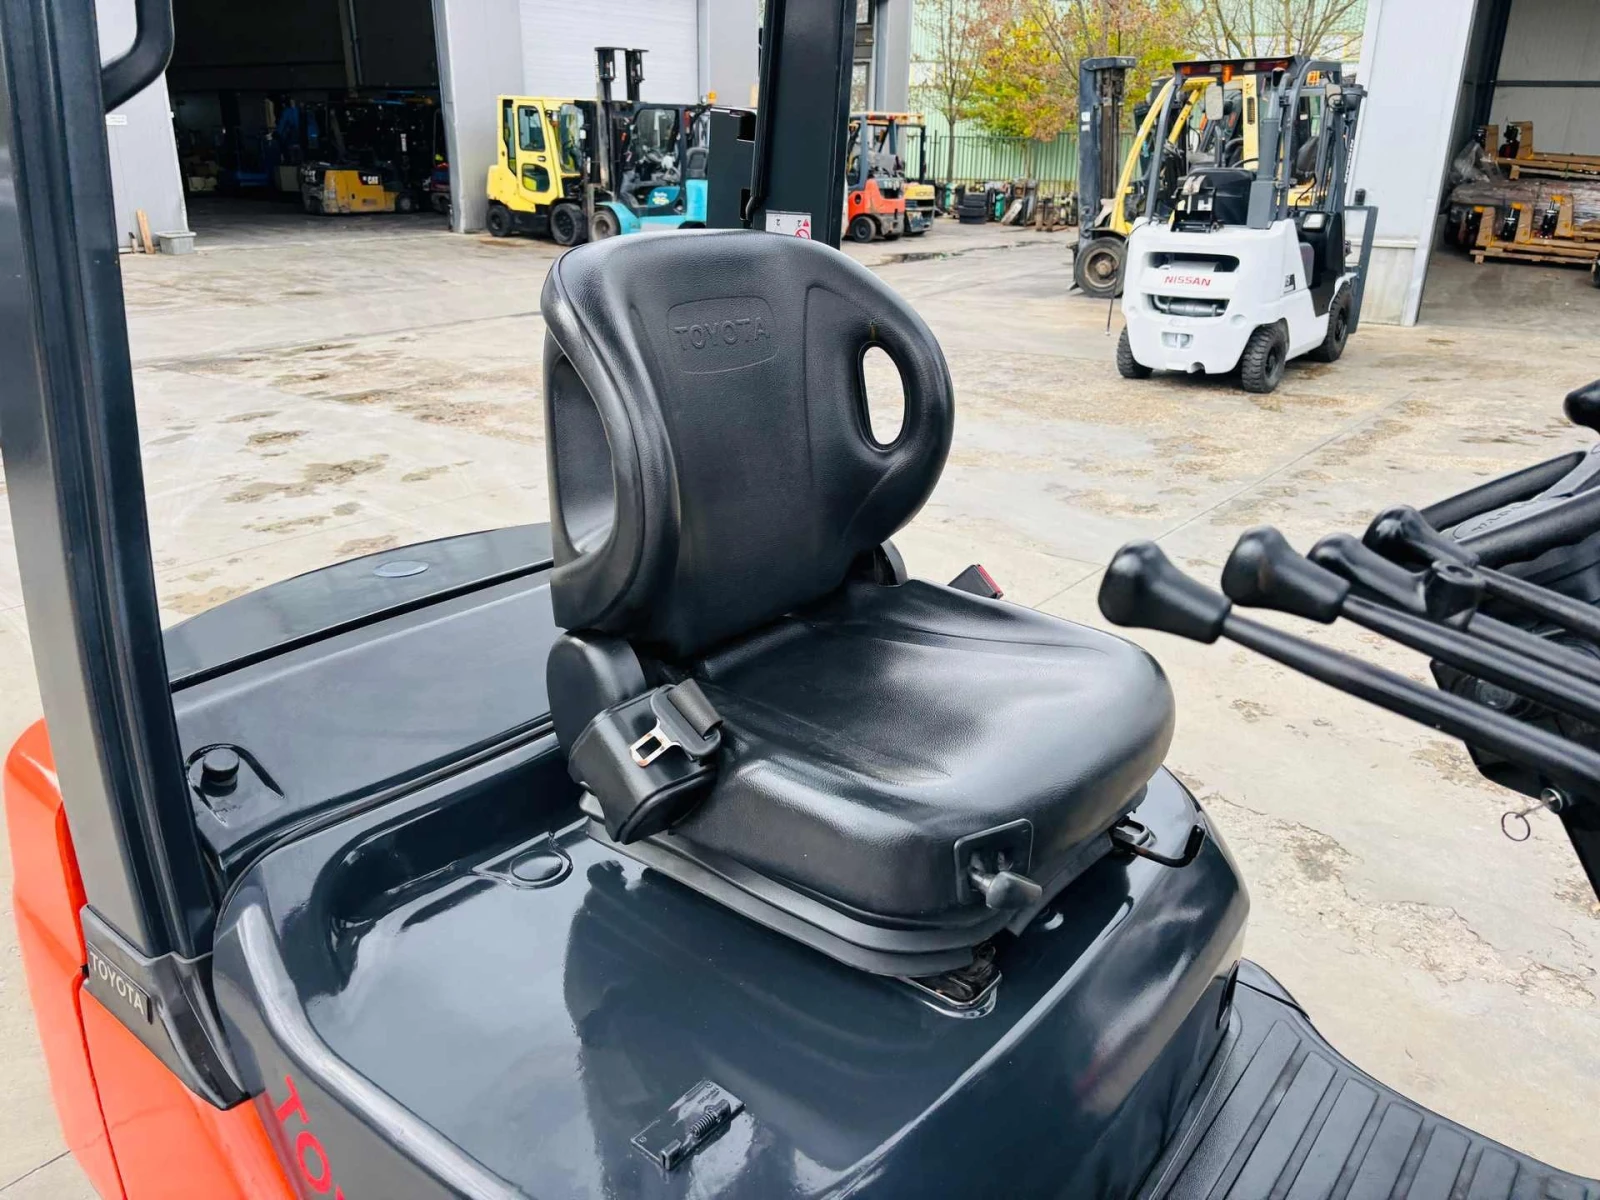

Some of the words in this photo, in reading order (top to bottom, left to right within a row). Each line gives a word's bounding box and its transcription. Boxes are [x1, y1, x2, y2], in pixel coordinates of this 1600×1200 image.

[1164, 275, 1211, 286] NISSAN
[673, 317, 771, 351] TOYOTA
[89, 951, 144, 1015] TOYOTA
[275, 1073, 346, 1200] TO
